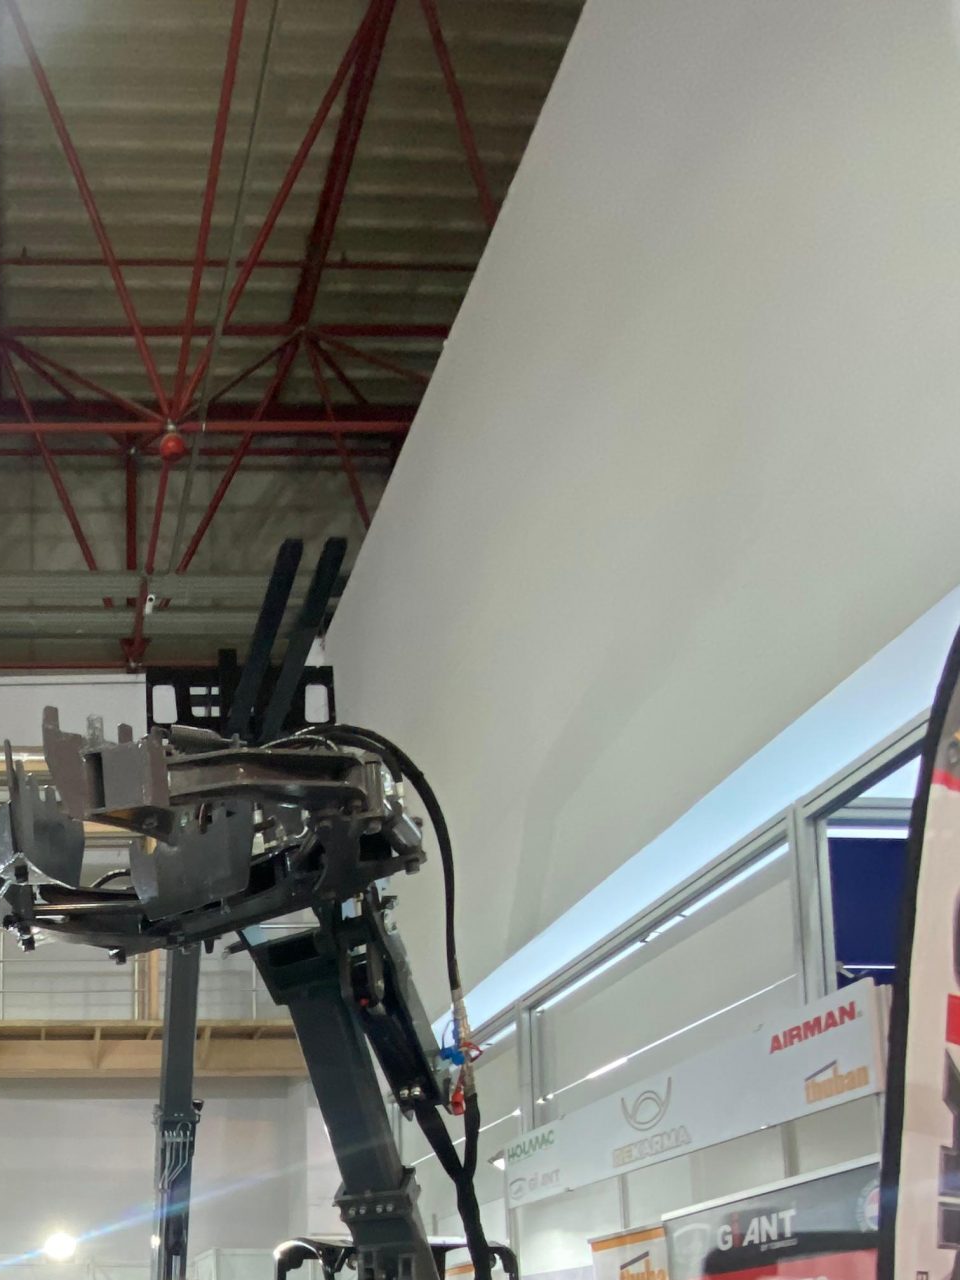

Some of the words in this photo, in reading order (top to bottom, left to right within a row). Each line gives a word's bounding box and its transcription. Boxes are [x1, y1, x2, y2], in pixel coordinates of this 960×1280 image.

[769, 1000, 856, 1054] AIRMAN
[507, 1129, 555, 1161] HOLMAC
[612, 1125, 692, 1168] REKARMA
